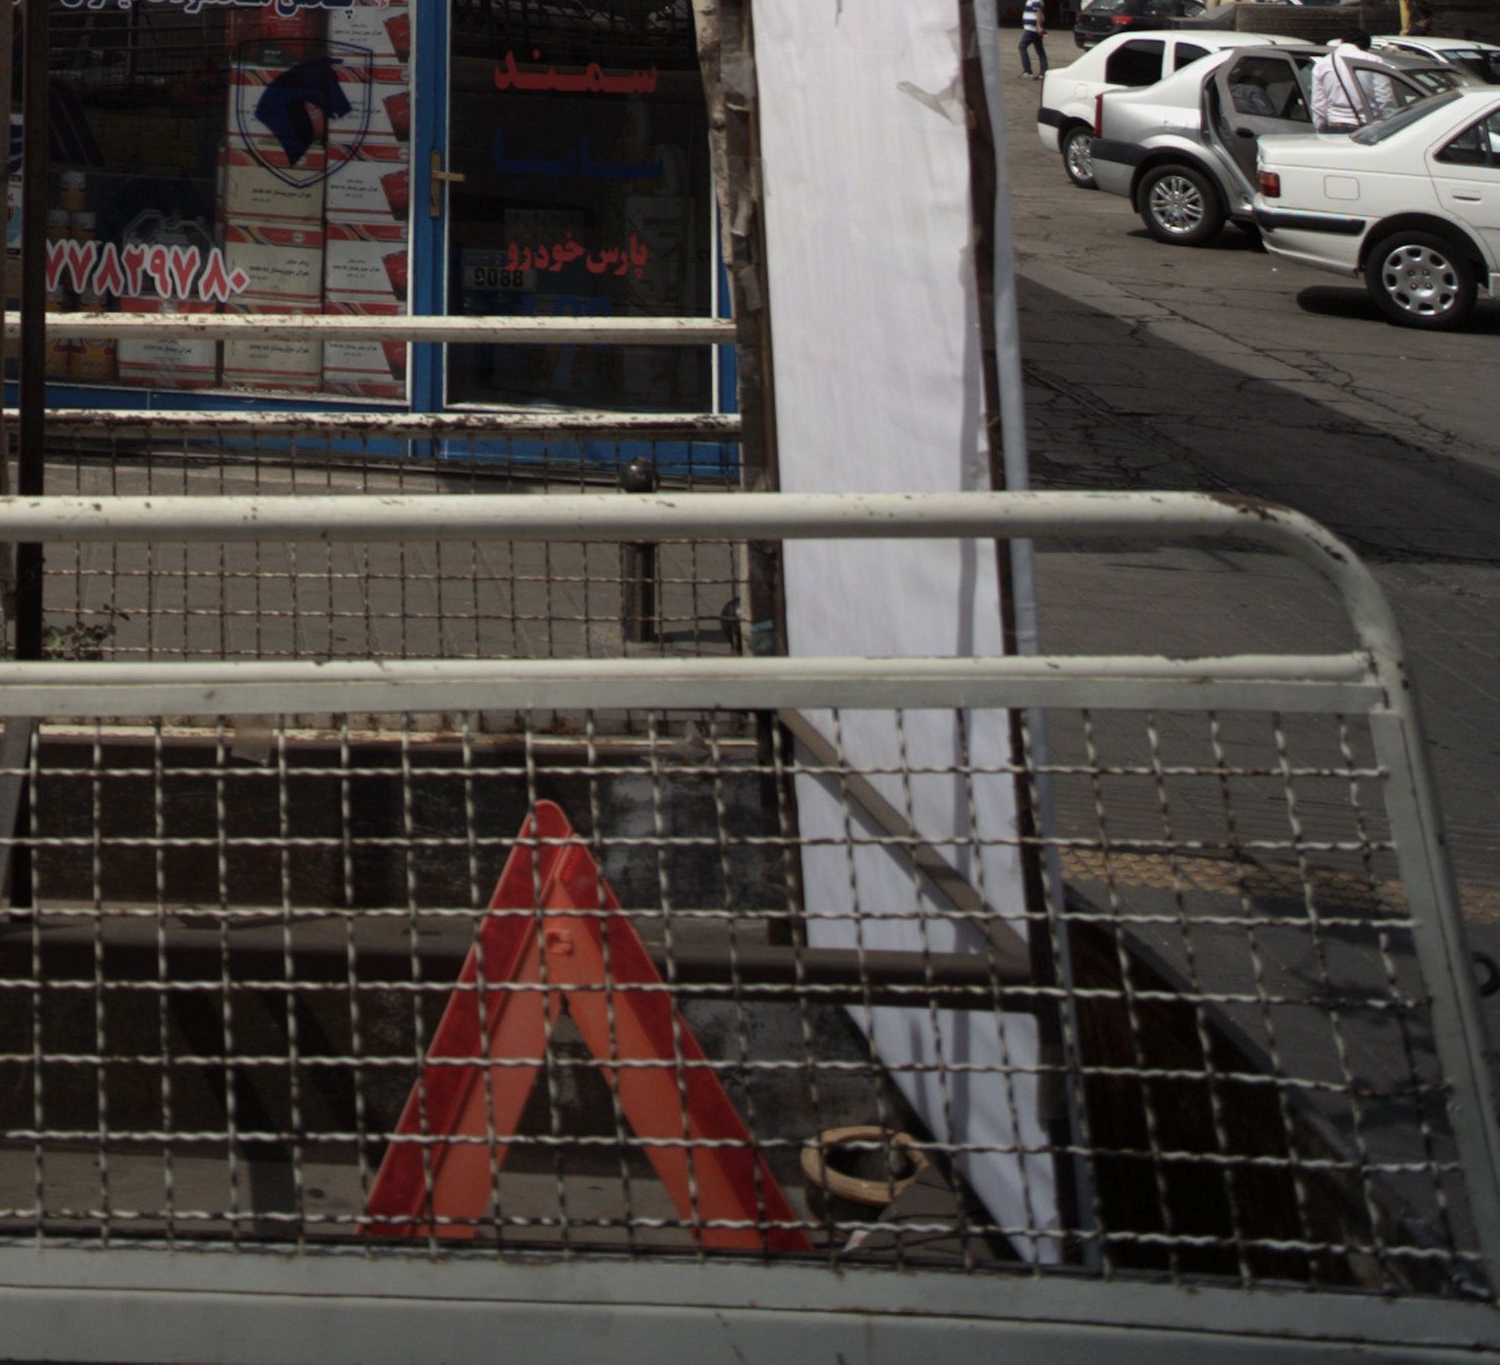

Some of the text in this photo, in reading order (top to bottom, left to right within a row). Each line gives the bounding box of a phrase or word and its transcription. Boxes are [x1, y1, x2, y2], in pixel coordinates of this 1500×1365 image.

[492, 47, 659, 95] سمند
[503, 230, 650, 279] پارس خودرو
